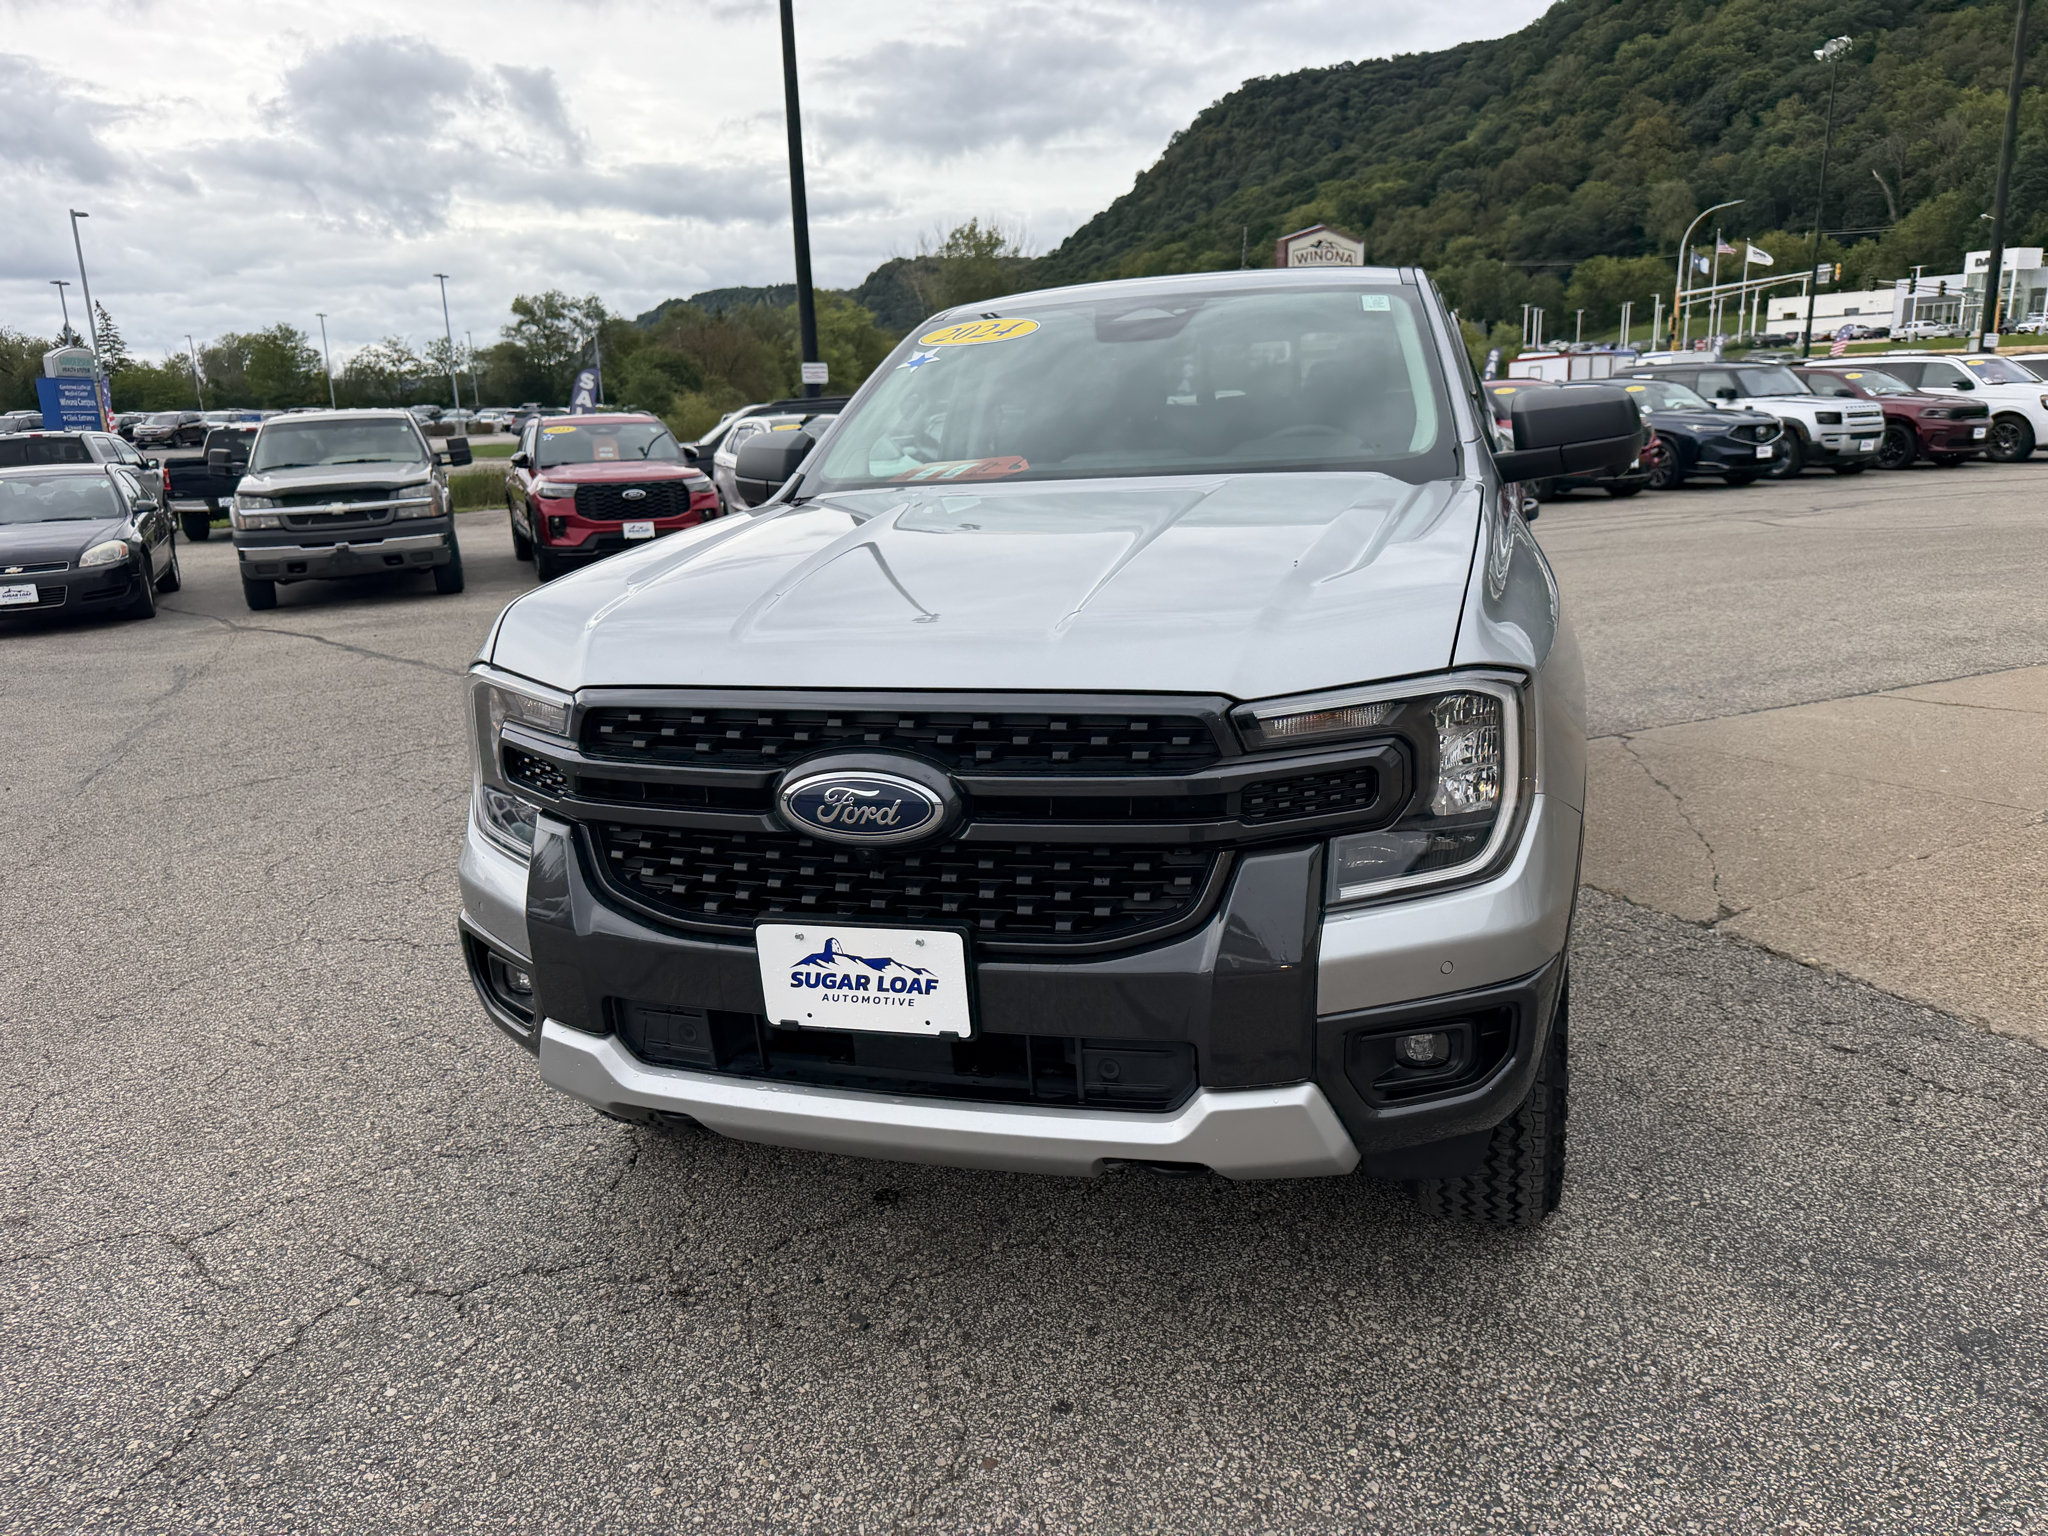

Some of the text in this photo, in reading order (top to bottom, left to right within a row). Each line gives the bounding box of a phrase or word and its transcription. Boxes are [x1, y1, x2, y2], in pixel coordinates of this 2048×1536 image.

[1295, 250, 1354, 265] WINONA
[929, 321, 1026, 343] 2024
[816, 786, 902, 826] Ford
[790, 970, 939, 996] SUGAR LOAF
[821, 993, 916, 1008] AUTOMOTIVE
